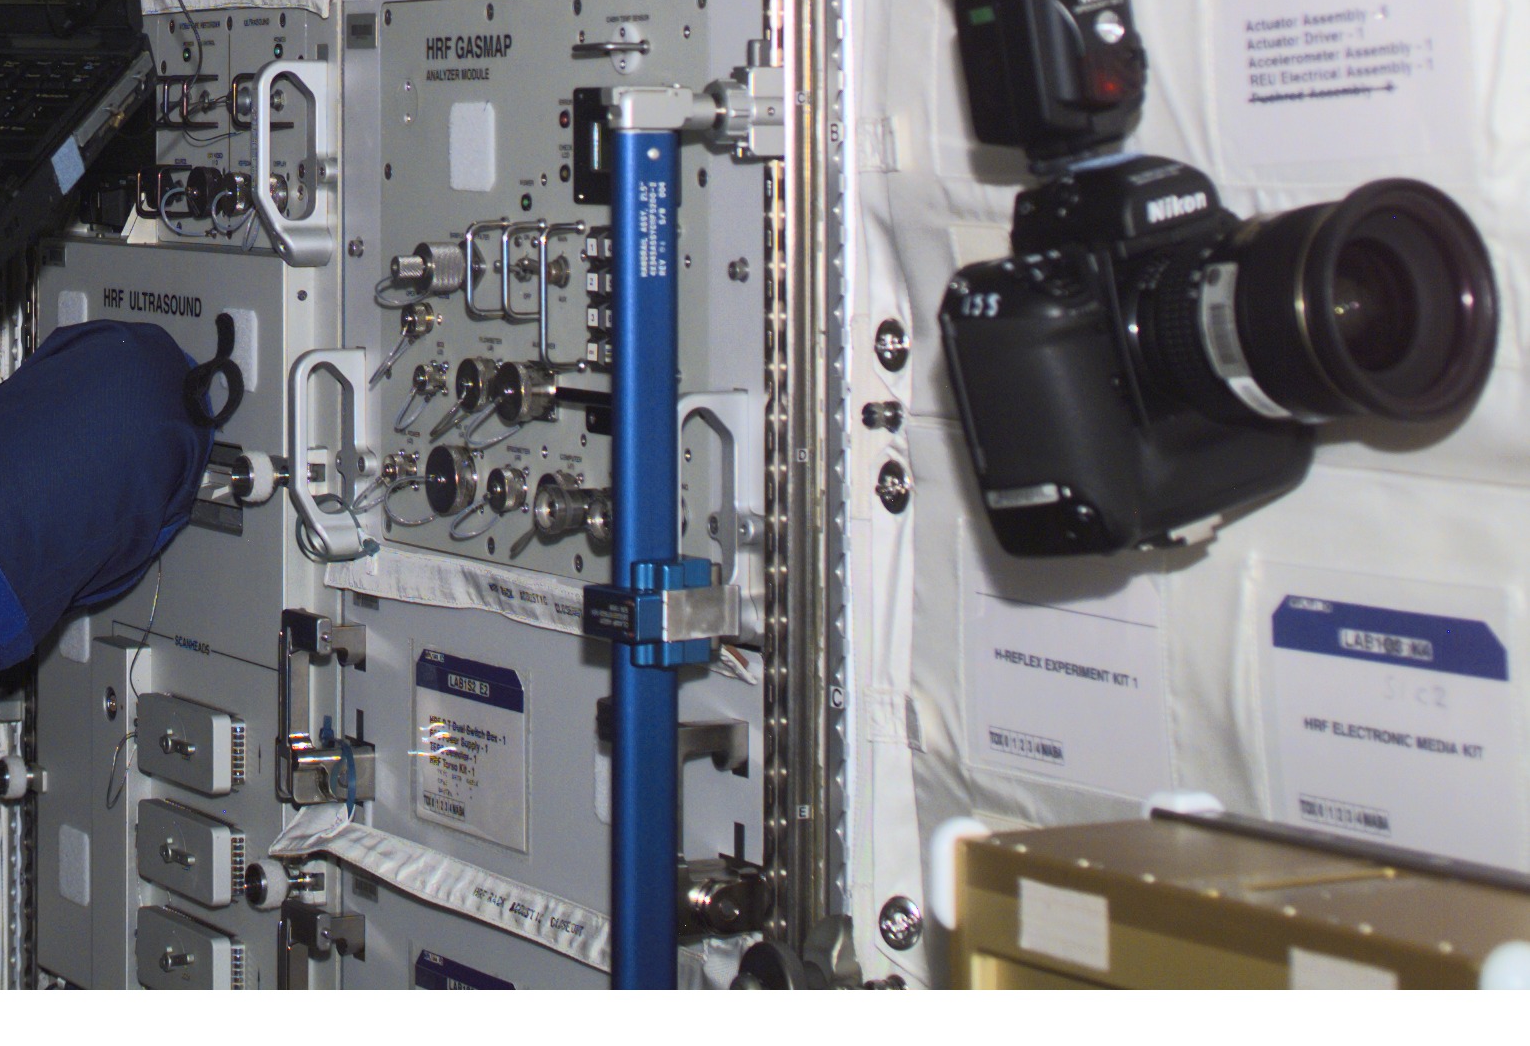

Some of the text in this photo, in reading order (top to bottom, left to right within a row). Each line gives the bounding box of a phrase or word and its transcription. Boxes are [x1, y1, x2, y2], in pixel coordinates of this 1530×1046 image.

[1245, 8, 1367, 33] Actuator Assembly
[426, 33, 513, 60] HRF GASMAP
[1246, 35, 1299, 52] Actuator
[1304, 30, 1344, 46] Driver
[1248, 50, 1339, 69] Accelerometer
[1345, 41, 1410, 59] Assembly
[426, 68, 490, 81] ANALYZER MODULE
[1346, 61, 1412, 79] Assembly
[831, 123, 839, 142] B
[1147, 191, 1207, 224] Nikon
[103, 288, 202, 317] HRF ULTRASOUND
[174, 635, 210, 655] SCANHEADS
[994, 648, 1042, 669] H-REFLEX
[1045, 658, 1110, 683] EXPERIMENT
[1113, 672, 1130, 687] KIT
[449, 675, 488, 696] LAB1S2 E2
[832, 688, 843, 708] C
[1304, 717, 1484, 759] HRF ELECTRONIC MEDIA KIT
[798, 806, 807, 818] E
[550, 916, 584, 937] CLOSEOUT
